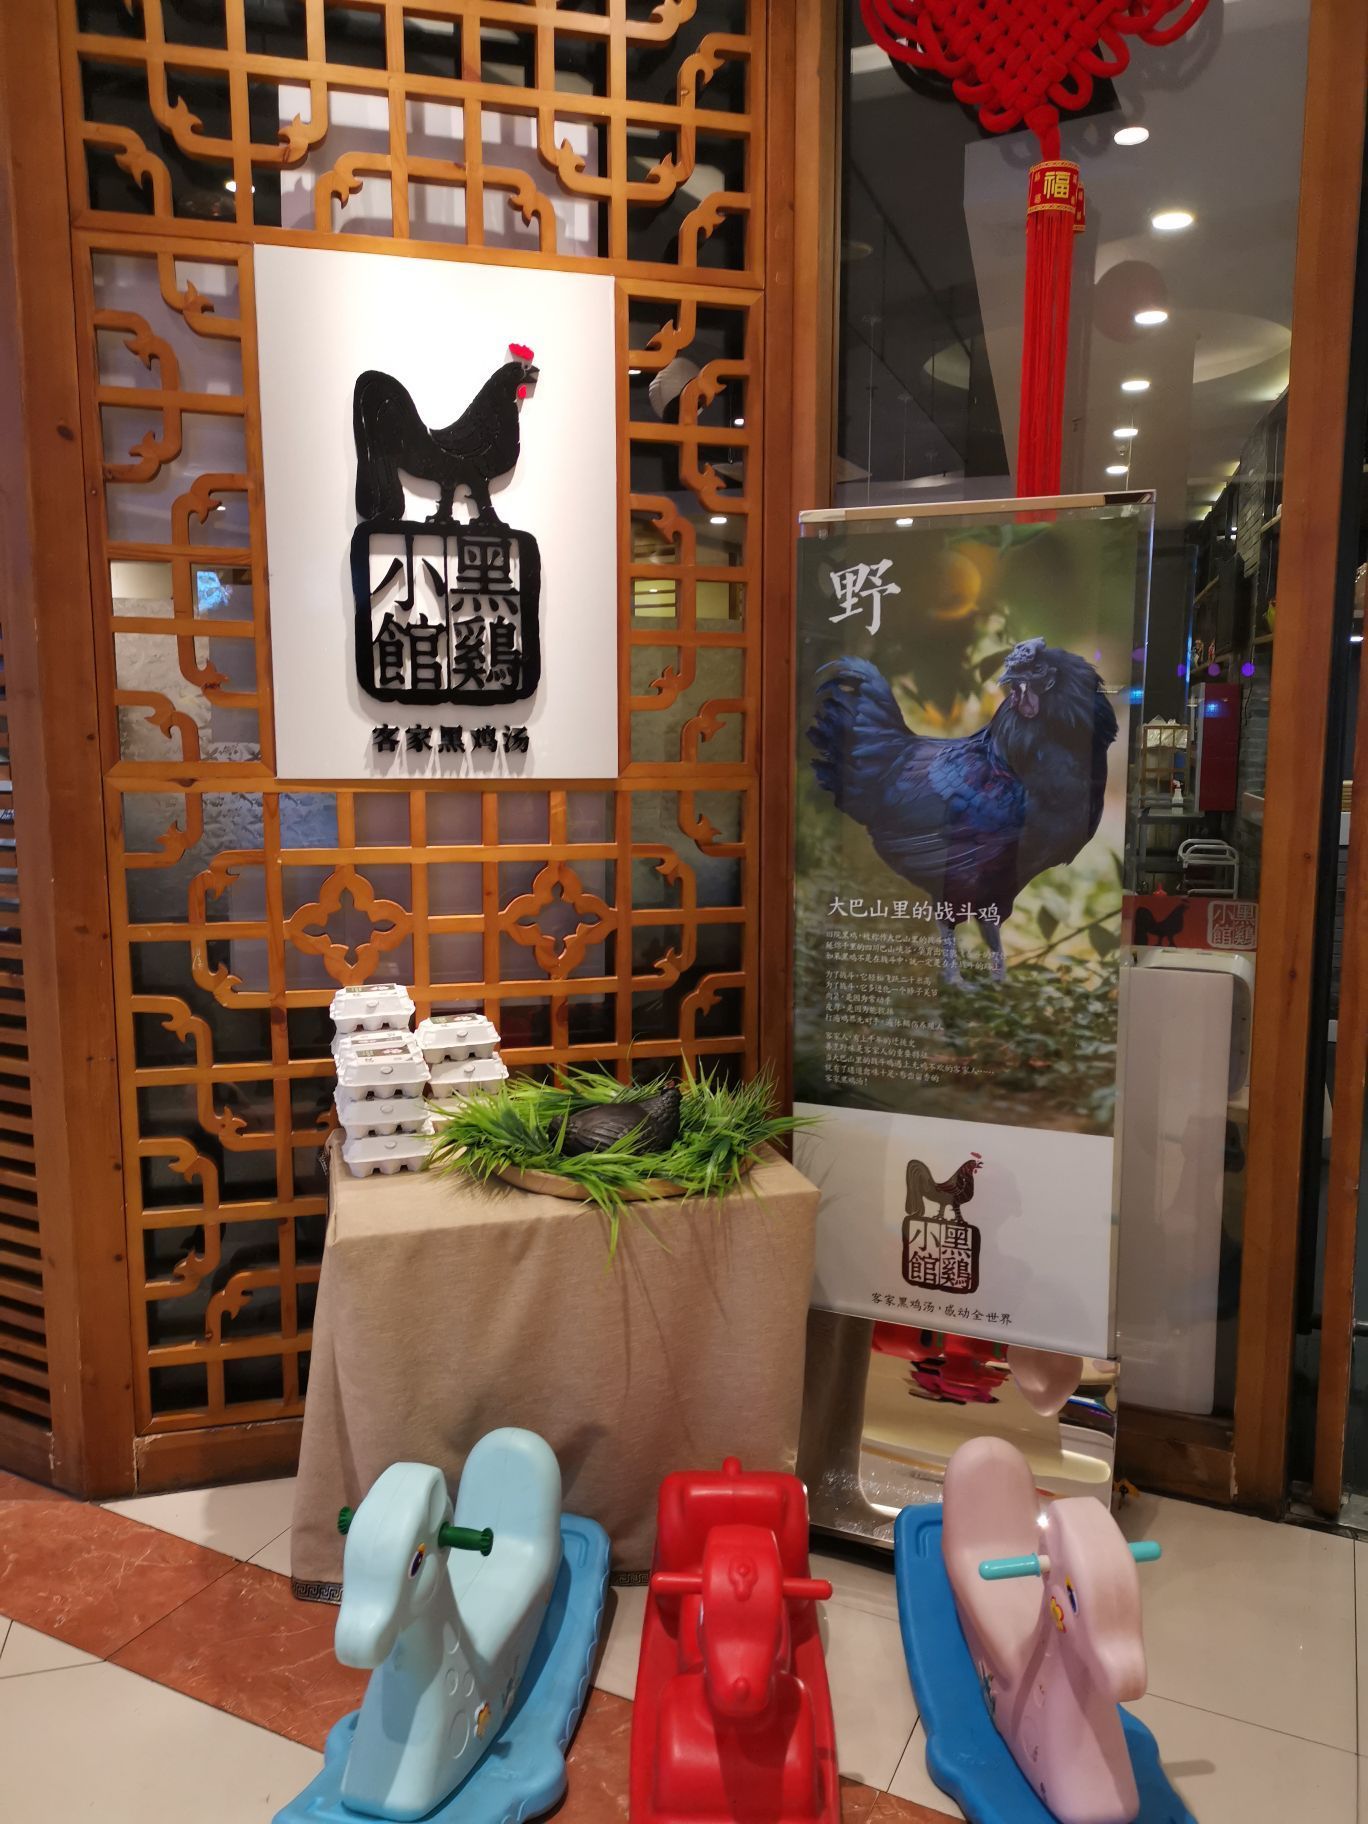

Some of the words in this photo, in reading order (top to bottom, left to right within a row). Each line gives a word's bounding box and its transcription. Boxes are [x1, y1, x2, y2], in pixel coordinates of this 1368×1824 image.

[1043, 171, 1071, 199] 福
[828, 558, 901, 636] 野
[372, 724, 530, 753] 客家黑鸡汤
[827, 896, 1001, 926] 大巴山里的战斗鸡
